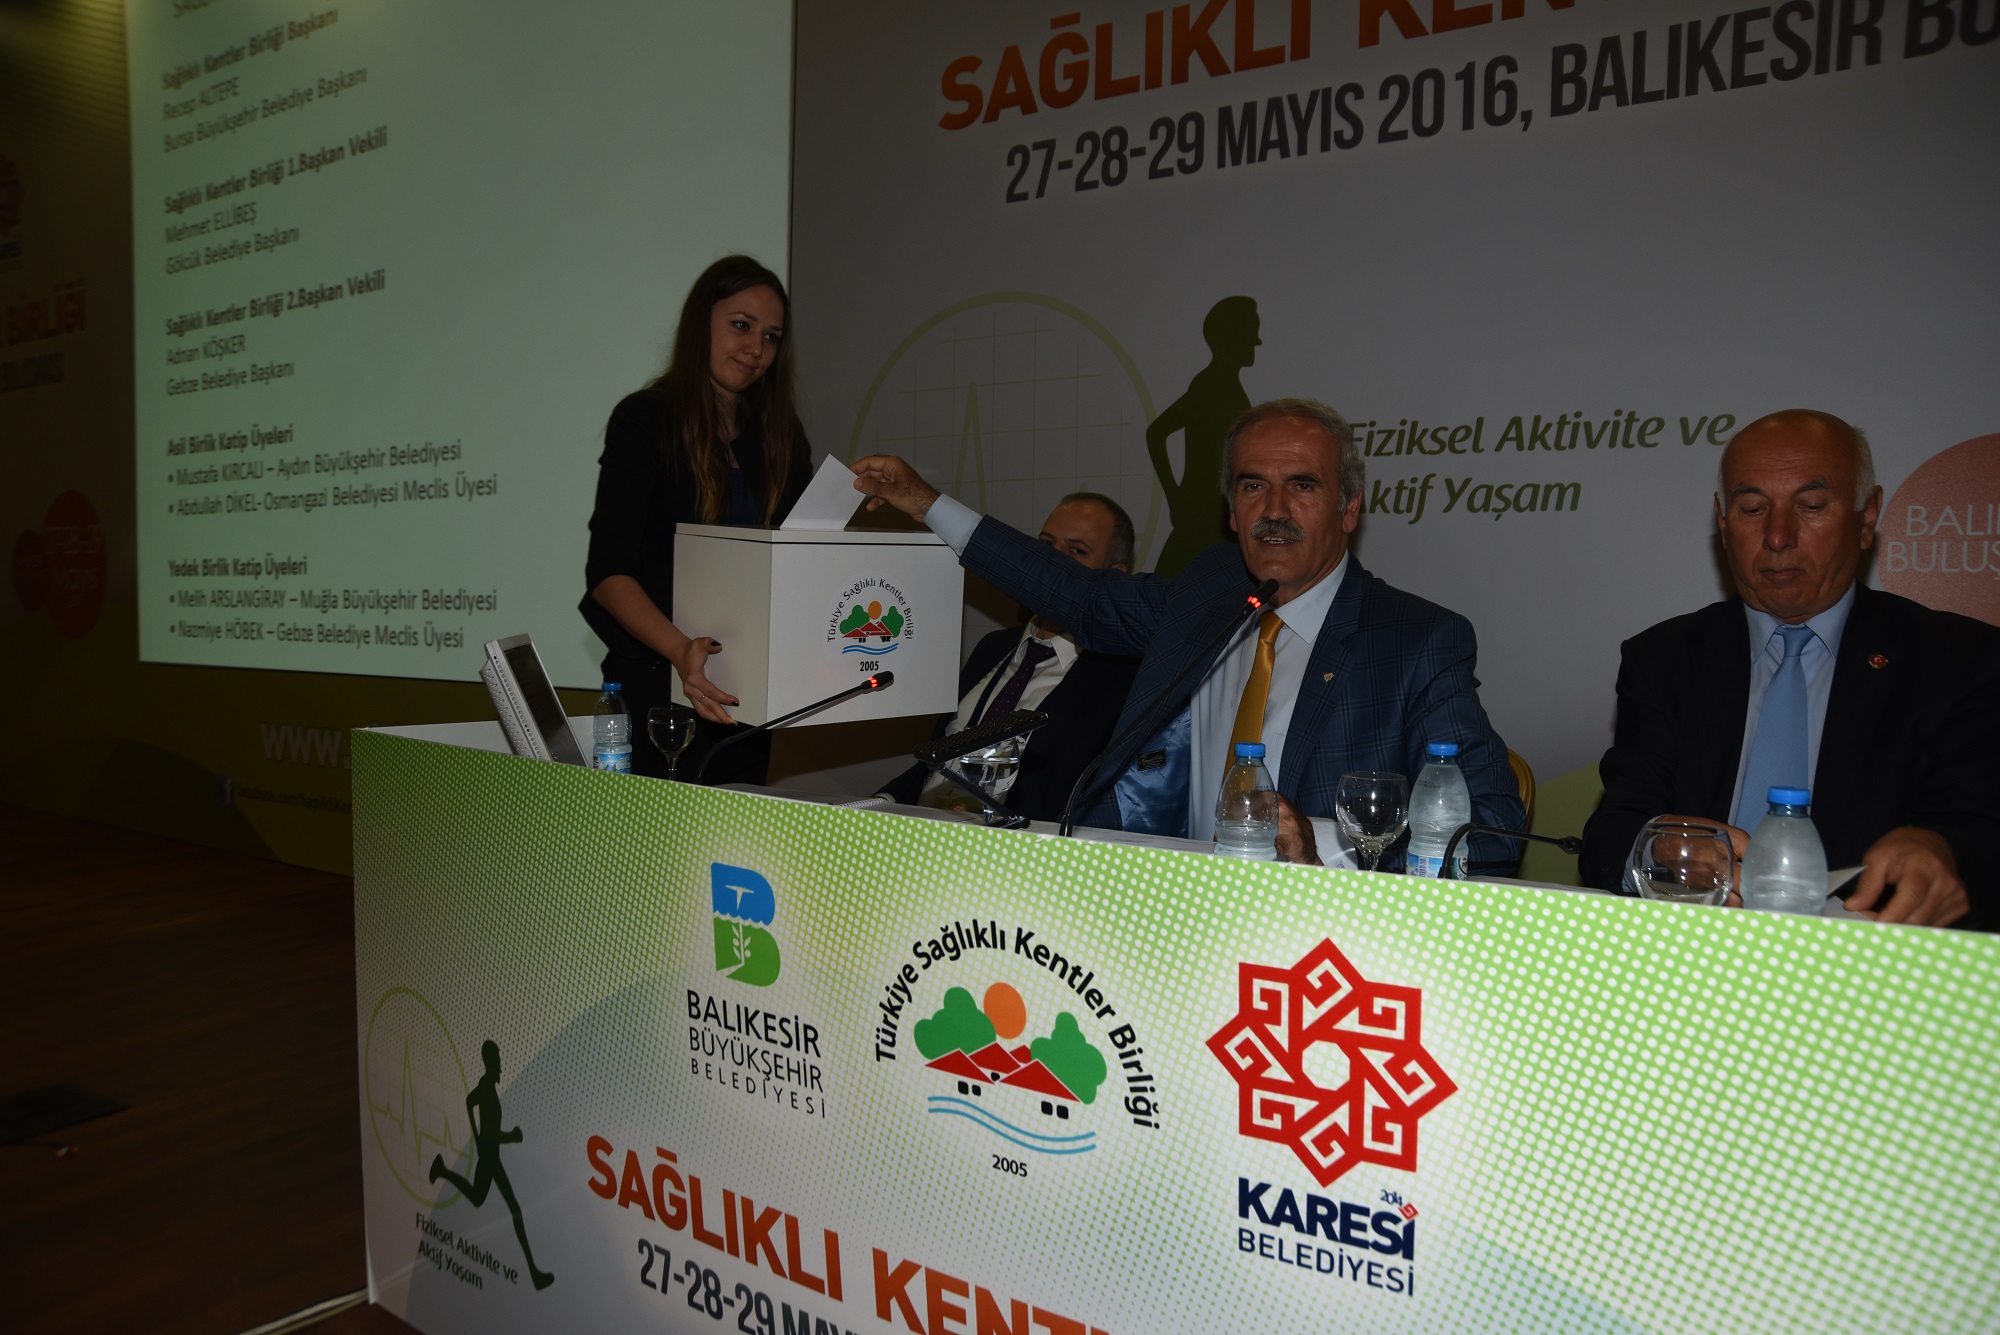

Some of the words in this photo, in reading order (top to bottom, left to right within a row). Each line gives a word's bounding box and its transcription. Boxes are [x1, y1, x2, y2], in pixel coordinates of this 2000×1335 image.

[938, 0, 1311, 130] SAĞLIKLI
[350, 126, 388, 157] Vekili
[1005, 111, 1206, 204] 27-28-29
[1217, 82, 1364, 169] MAYIS
[1378, 54, 1533, 144] 2016,
[347, 268, 386, 297] Vekili
[219, 430, 249, 452] Katip
[251, 423, 294, 450] Üyeleri
[1495, 408, 1665, 452] Aktivite
[1680, 412, 1736, 447] ve
[277, 455, 311, 481] Aydın
[314, 447, 386, 477] Büyükşehir
[389, 438, 462, 468] Belediyesi
[332, 482, 399, 509] Belediyesi
[403, 477, 449, 502] Meclis
[455, 470, 498, 502] Üyesi
[1359, 472, 1437, 525] ktif
[1442, 477, 1582, 521] Yaşam
[1906, 503, 2000, 537] BALI
[168, 558, 200, 577] Yedek
[233, 557, 262, 580] Katip
[265, 552, 308, 580] Üyeleri
[301, 588, 339, 614] Muğla
[343, 588, 418, 615] Büyükşehir
[422, 588, 497, 616] Belediyesi
[827, 601, 845, 642] Türkiye
[843, 577, 876, 601] Sağlıklı
[879, 578, 907, 606] Kentler
[903, 607, 914, 640] Birliği
[276, 623, 313, 643] Gebze
[317, 623, 371, 649] Belediye
[375, 624, 419, 647] Meclis
[424, 620, 464, 652] Üyesi
[859, 661, 880, 672] 2005
[687, 989, 822, 1059] BALIKESİR
[875, 963, 919, 1062] Türkiye
[912, 919, 1006, 970] Sağlıklı
[1014, 927, 1117, 1020] Kentler
[1108, 1023, 1161, 1129] Birliği
[689, 1026, 824, 1094] BÜYÜKŞEHİR
[992, 1154, 1029, 1178] 2005
[587, 1134, 843, 1303] SAĞLIKLI
[416, 1211, 455, 1249] Fiziksel
[456, 1236, 501, 1275] Aktivite
[502, 1264, 519, 1285] ve
[418, 1239, 444, 1271] Aktif
[444, 1253, 484, 1291] Yaşam
[1238, 1227, 1414, 1297] BELEDİYESİ
[637, 1237, 777, 1335] 27-28-29
[872, 1246, 1112, 1335] KEN
